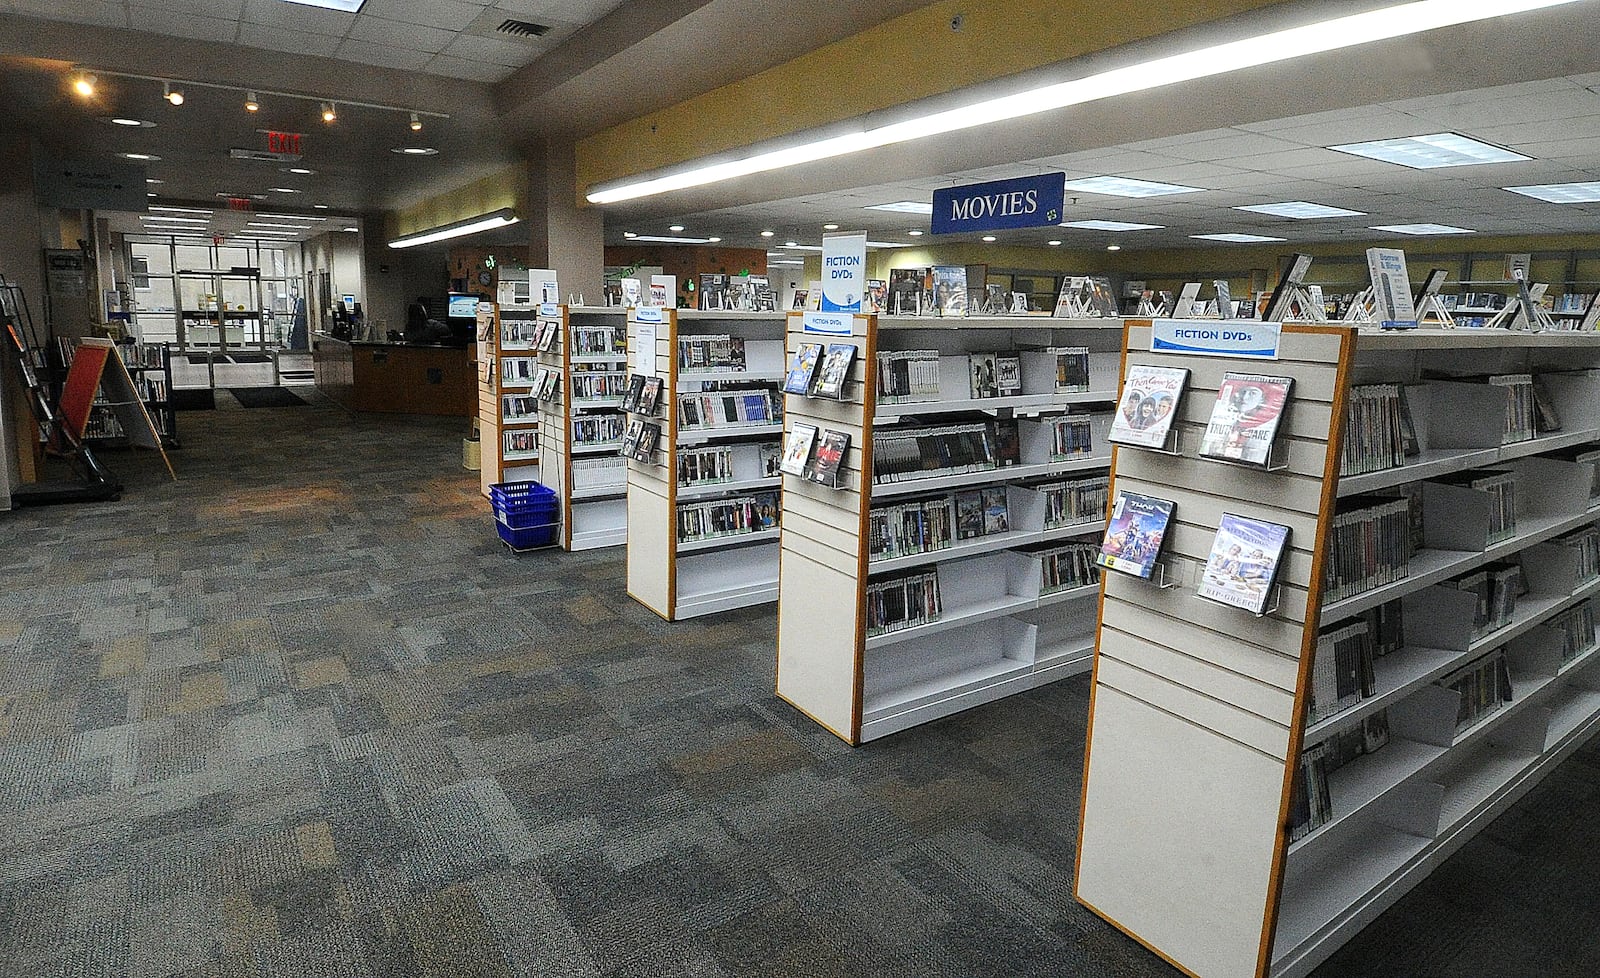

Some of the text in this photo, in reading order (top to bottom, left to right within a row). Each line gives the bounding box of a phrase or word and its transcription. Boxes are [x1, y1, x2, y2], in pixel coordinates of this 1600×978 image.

[268, 131, 301, 155] EXIT
[950, 189, 1038, 221] MOVIES
[826, 255, 860, 267] FICTION
[831, 269, 853, 279] DVDs
[1175, 329, 1252, 342] FICTION DVDs
